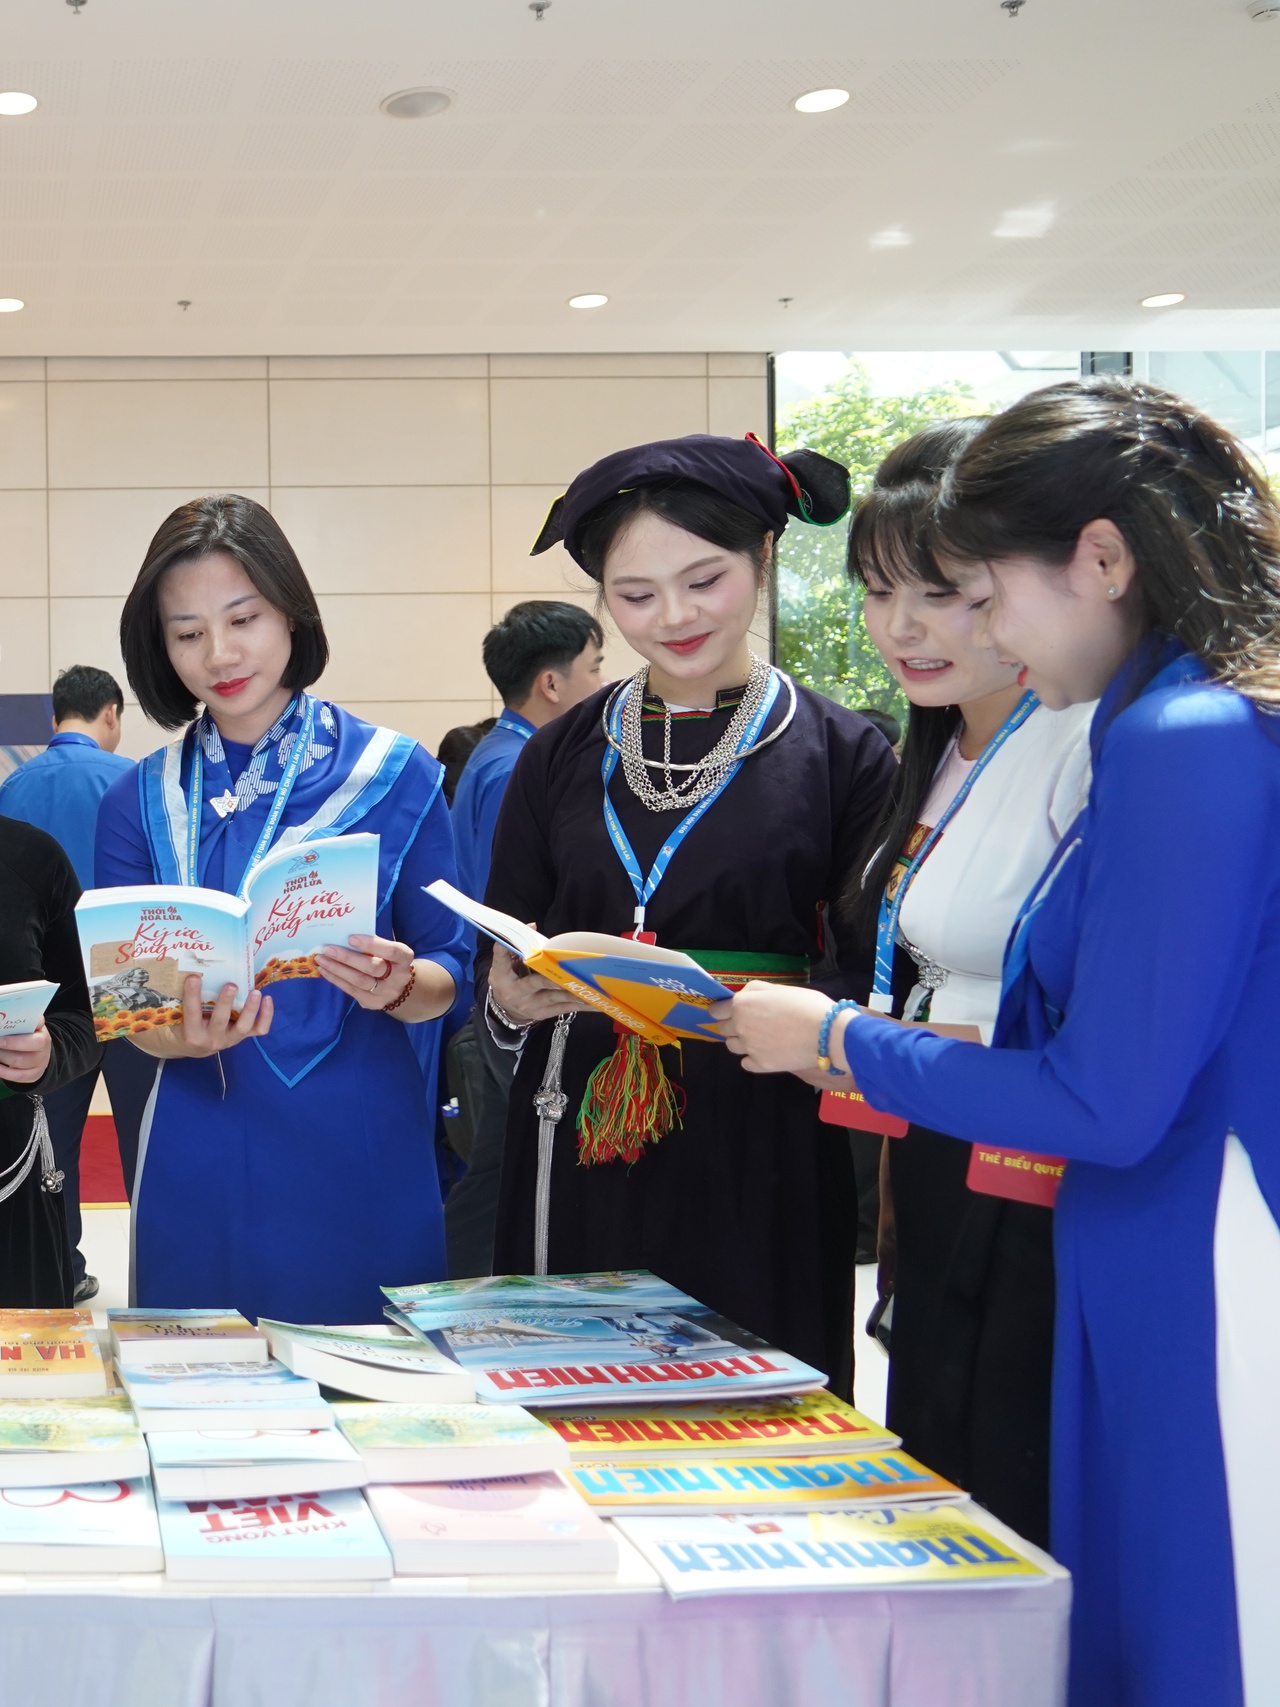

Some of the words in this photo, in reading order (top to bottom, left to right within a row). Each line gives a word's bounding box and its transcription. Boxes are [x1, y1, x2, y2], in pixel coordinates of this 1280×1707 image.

[287, 763, 296, 777] MINH
[257, 840, 267, 854] TOÀN
[263, 825, 273, 840] QUỐC
[269, 810, 279, 825] ĐOÀN
[678, 824, 688, 834] ĐẠI
[283, 885, 302, 894] HOA
[304, 879, 322, 888] LỬA
[285, 876, 307, 888] THỜI
[163, 913, 183, 921] LỬA
[268, 894, 311, 922] Ký
[310, 890, 344, 905] ức
[133, 922, 174, 947] Ký
[175, 926, 204, 939] ức
[253, 917, 308, 956] Sống
[306, 902, 355, 921] mãi
[115, 939, 171, 964] Sống
[172, 939, 214, 951] mãi
[564, 981, 584, 993] MỞ
[580, 988, 601, 1003] CỬA
[978, 1151, 1001, 1165] THẺ
[1004, 1154, 1031, 1170] BIỂU
[1033, 1161, 1065, 1177] QUYẾ
[485, 1365, 614, 1390] NIÊN
[607, 1353, 790, 1384] THANH
[546, 1419, 685, 1444] NIÊN
[677, 1411, 871, 1442] THANH
[572, 1465, 722, 1496] NIÊN
[723, 1456, 935, 1492] THANH
[199, 1500, 337, 1533] VIỆT
[283, 1520, 348, 1536] KHÁT
[656, 1541, 810, 1574] NIÊN
[806, 1533, 1024, 1570] THANH
